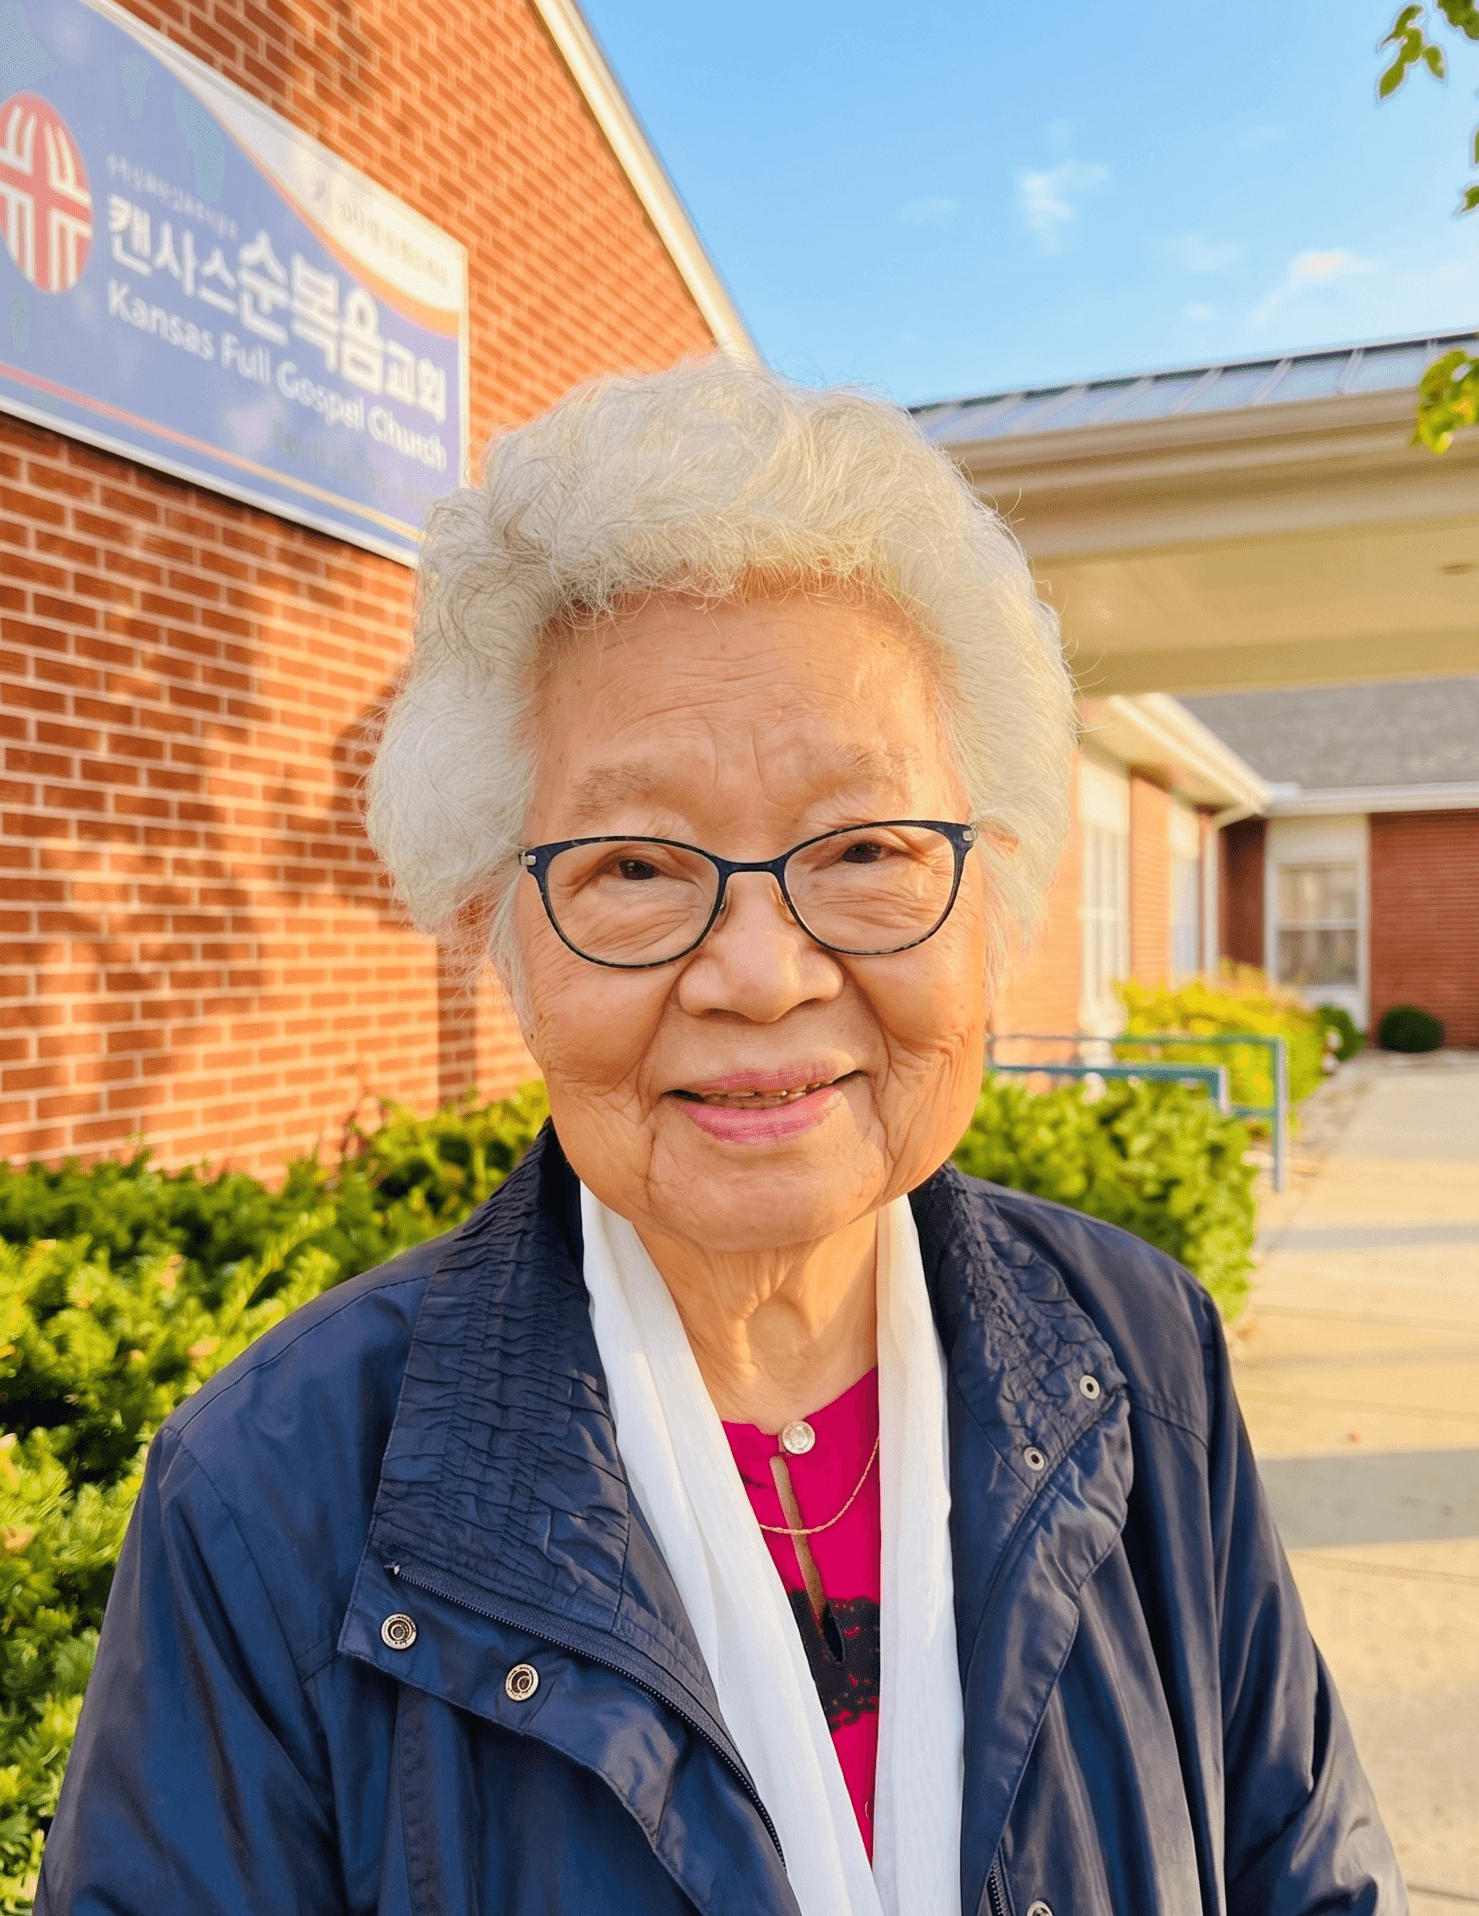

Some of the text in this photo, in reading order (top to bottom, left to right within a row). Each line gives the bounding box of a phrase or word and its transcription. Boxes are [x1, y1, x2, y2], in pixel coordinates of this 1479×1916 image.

[107, 279, 447, 472] Kansas Full Gospel Church
